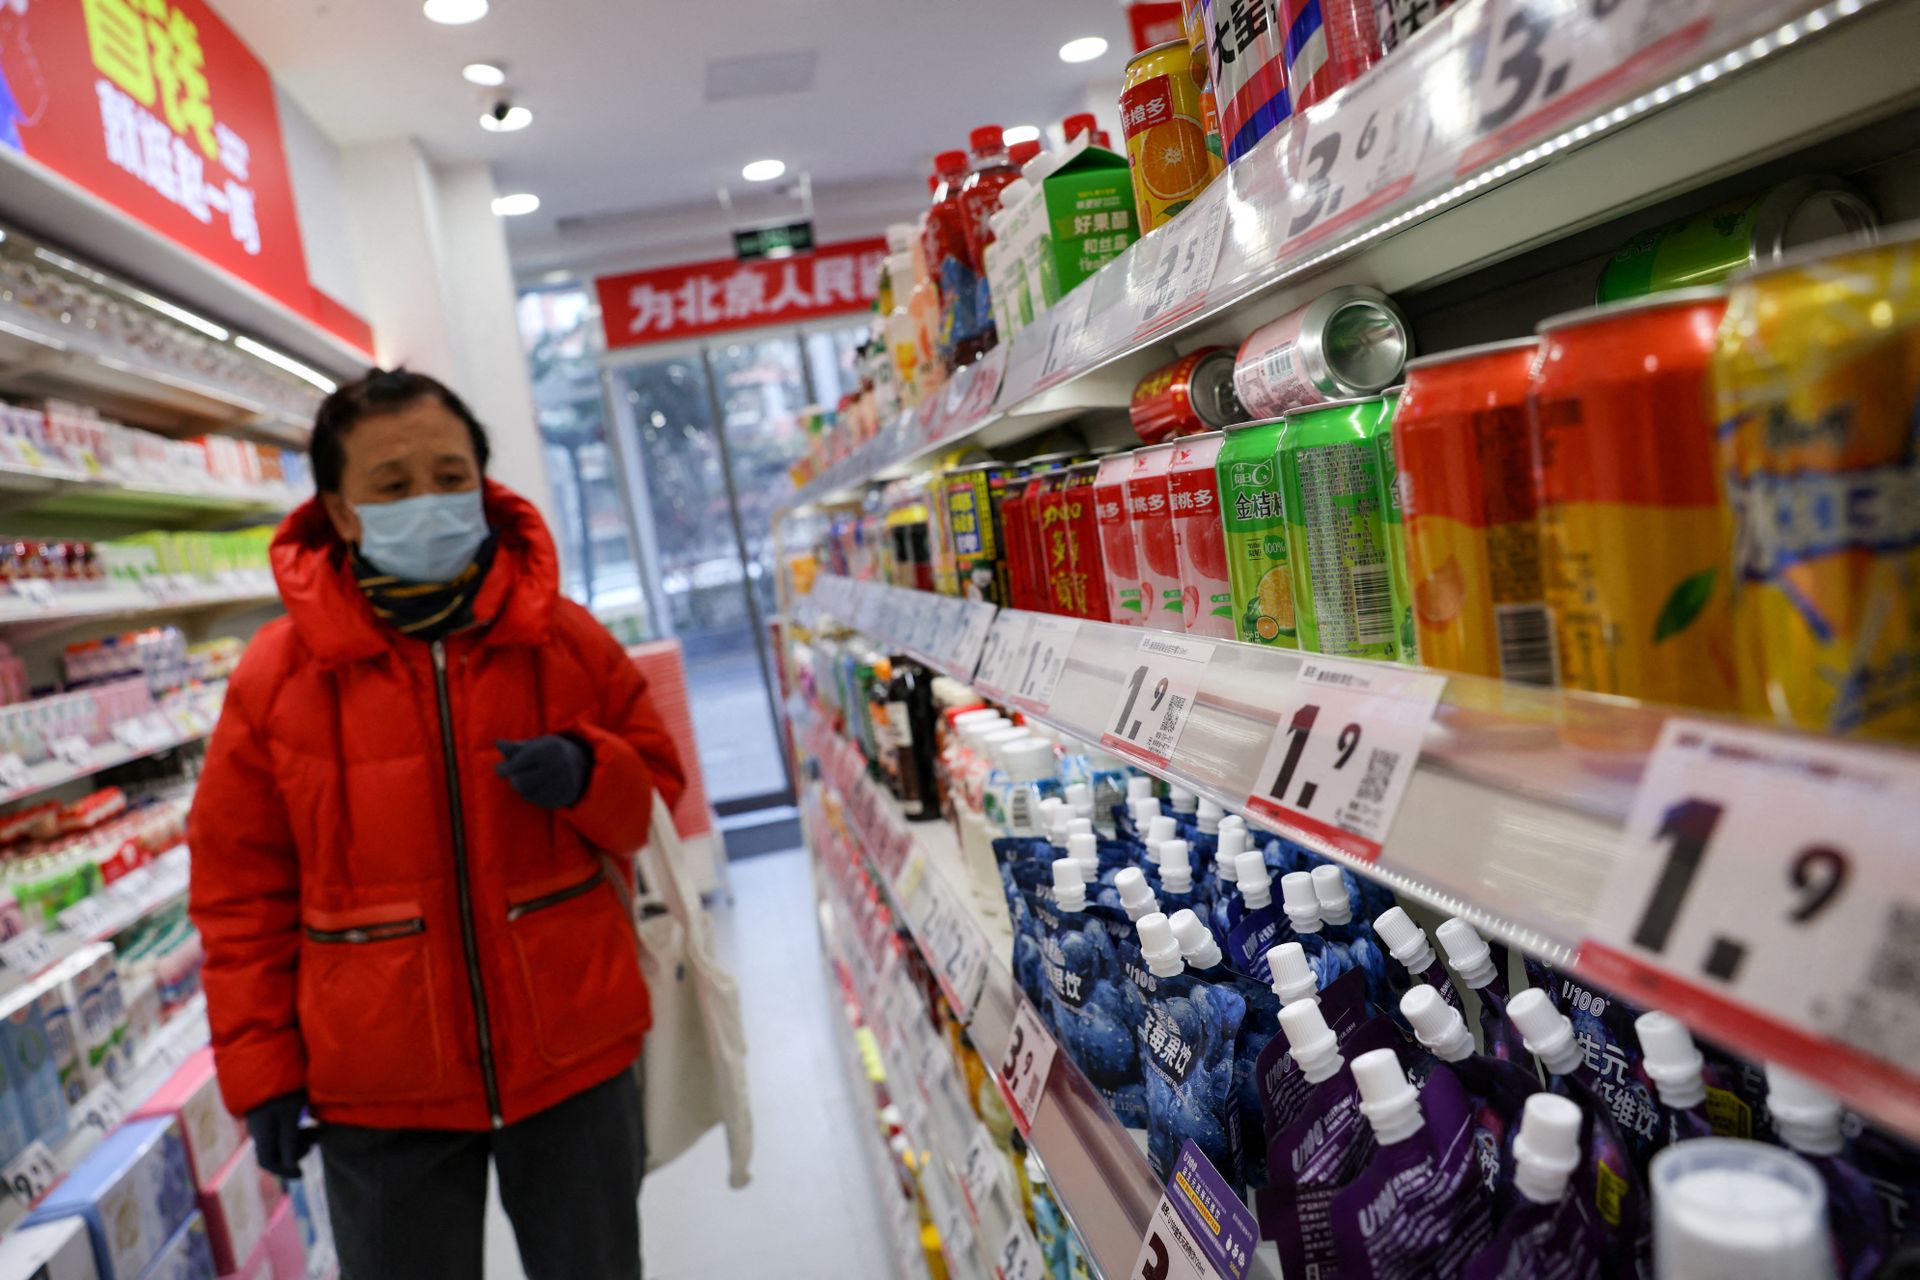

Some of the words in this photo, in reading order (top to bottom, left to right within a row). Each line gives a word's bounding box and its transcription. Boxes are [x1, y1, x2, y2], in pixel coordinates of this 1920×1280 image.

[1114, 665, 1169, 741] 1.9
[1270, 703, 1362, 809] 1.9
[1632, 796, 1855, 986] 1.9
[1003, 1025, 1034, 1092] 3.9
